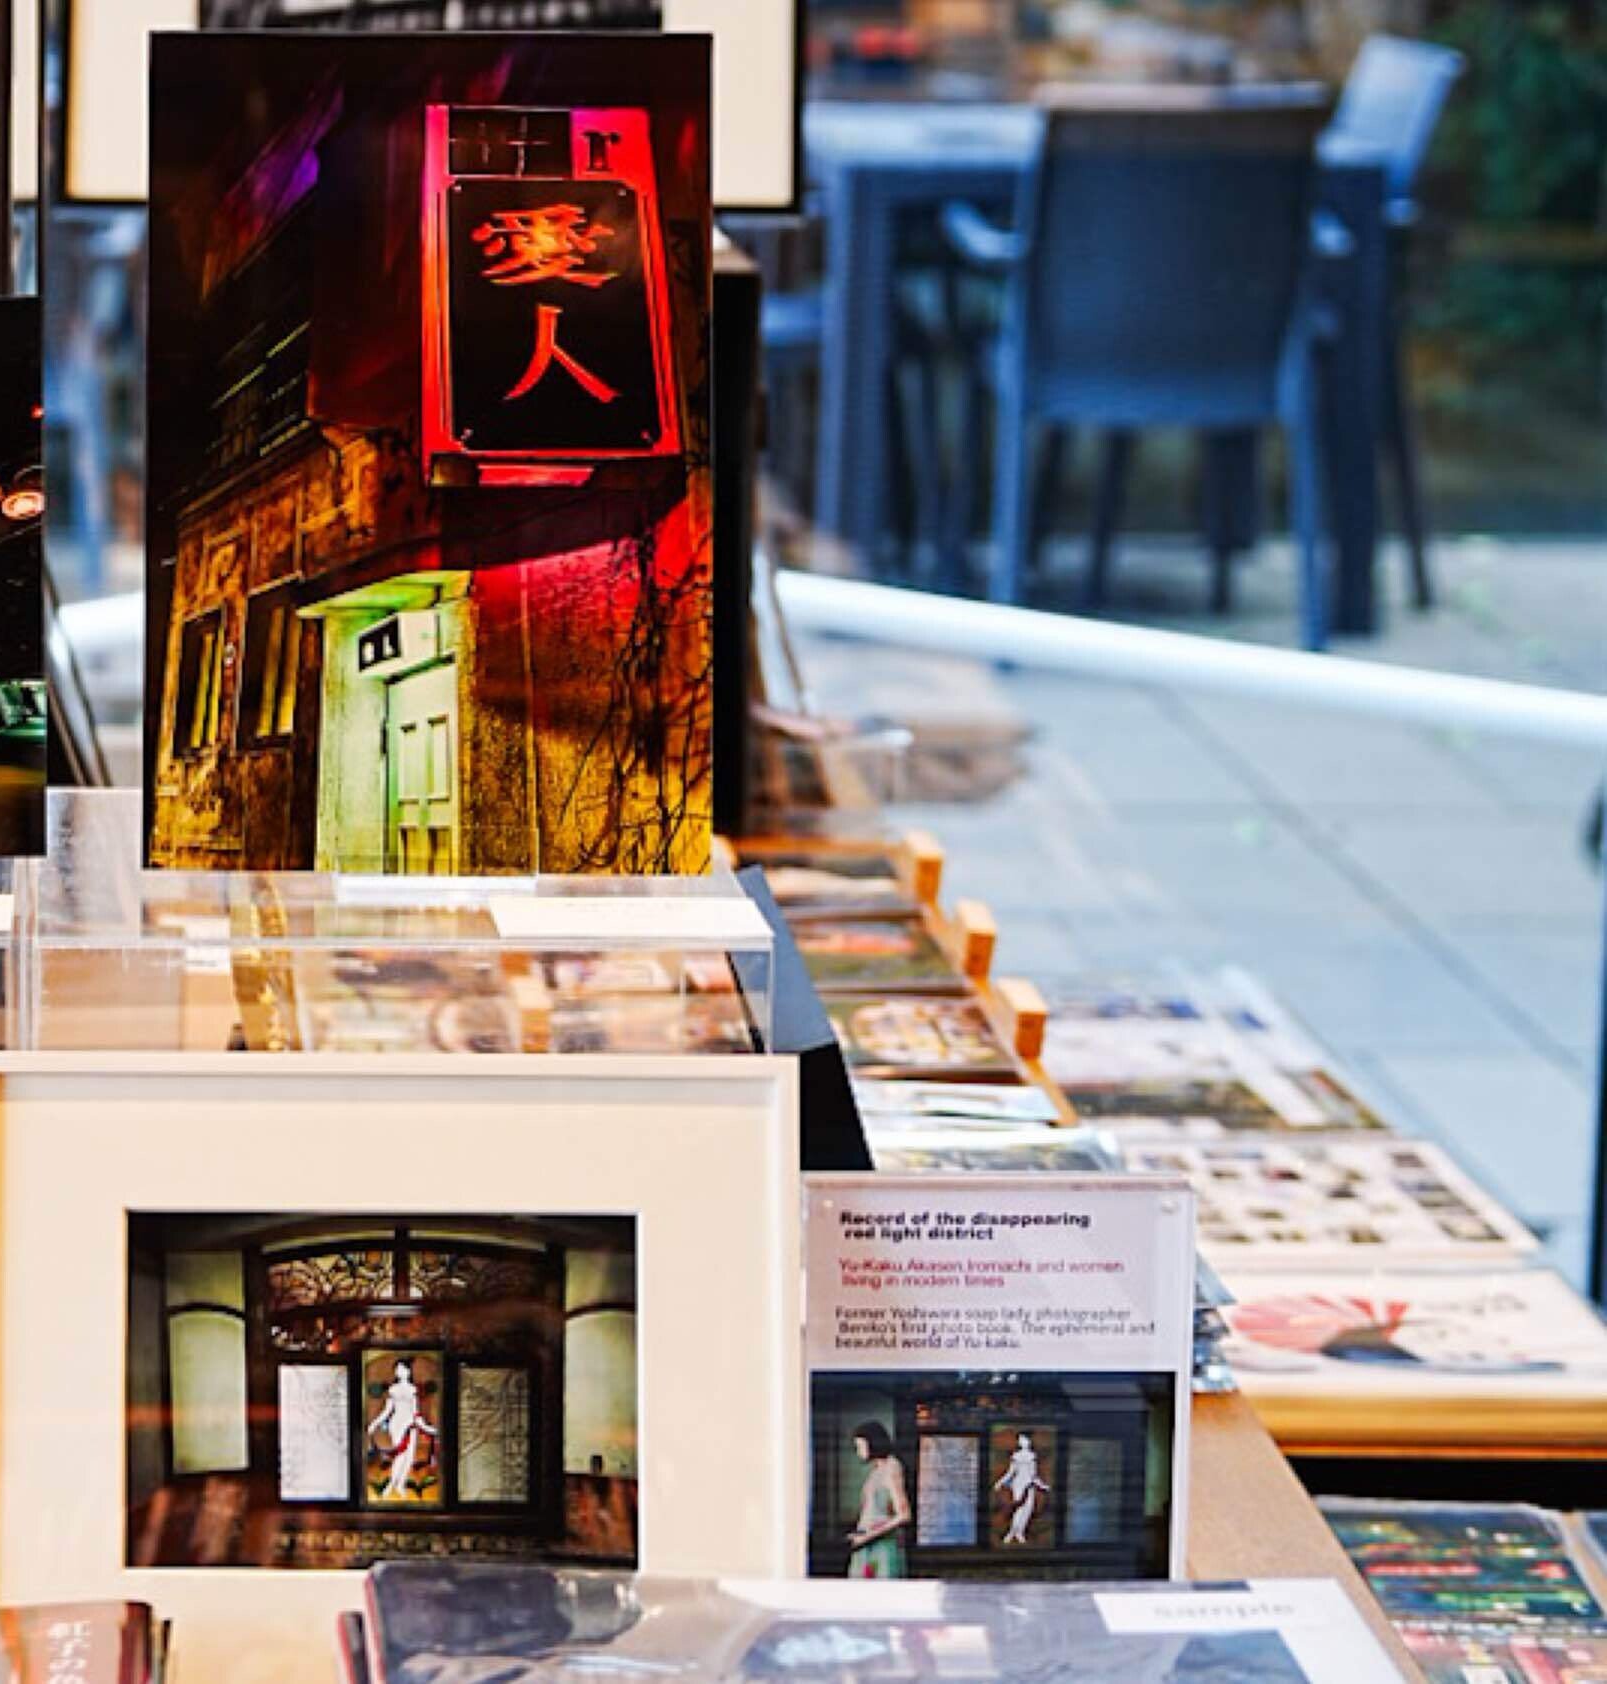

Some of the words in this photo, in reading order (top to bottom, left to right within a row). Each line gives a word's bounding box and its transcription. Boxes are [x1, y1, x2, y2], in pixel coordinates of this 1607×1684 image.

[582, 130, 620, 172] r
[471, 203, 623, 403] 愛人
[840, 1212, 905, 1225] Record
[911, 1212, 930, 1225] of
[936, 1212, 965, 1225] the
[971, 1212, 1091, 1228] disappearing
[844, 1227, 876, 1240] red
[881, 1227, 921, 1243] light
[928, 1227, 993, 1240] district
[1036, 1259, 1065, 1272] and
[1069, 1261, 1125, 1272] women
[842, 1275, 882, 1290] living
[885, 1276, 899, 1286] in
[902, 1276, 960, 1286] modern
[964, 1275, 1005, 1287] times
[835, 1305, 886, 1318] Former
[890, 1305, 960, 1318] Yoshiwara
[965, 1309, 998, 1321] soap
[1001, 1306, 1031, 1321] lady
[1036, 1306, 1131, 1321] photographer
[839, 1322, 896, 1333] Beniko's
[902, 1321, 927, 1333] first
[931, 1322, 973, 1336] photo
[1022, 1322, 1045, 1333] The
[1049, 1322, 1125, 1336] ephemeral
[1130, 1320, 1155, 1333] and
[835, 1335, 897, 1348] beautiful
[902, 1335, 941, 1348] world
[946, 1335, 960, 1348] of
